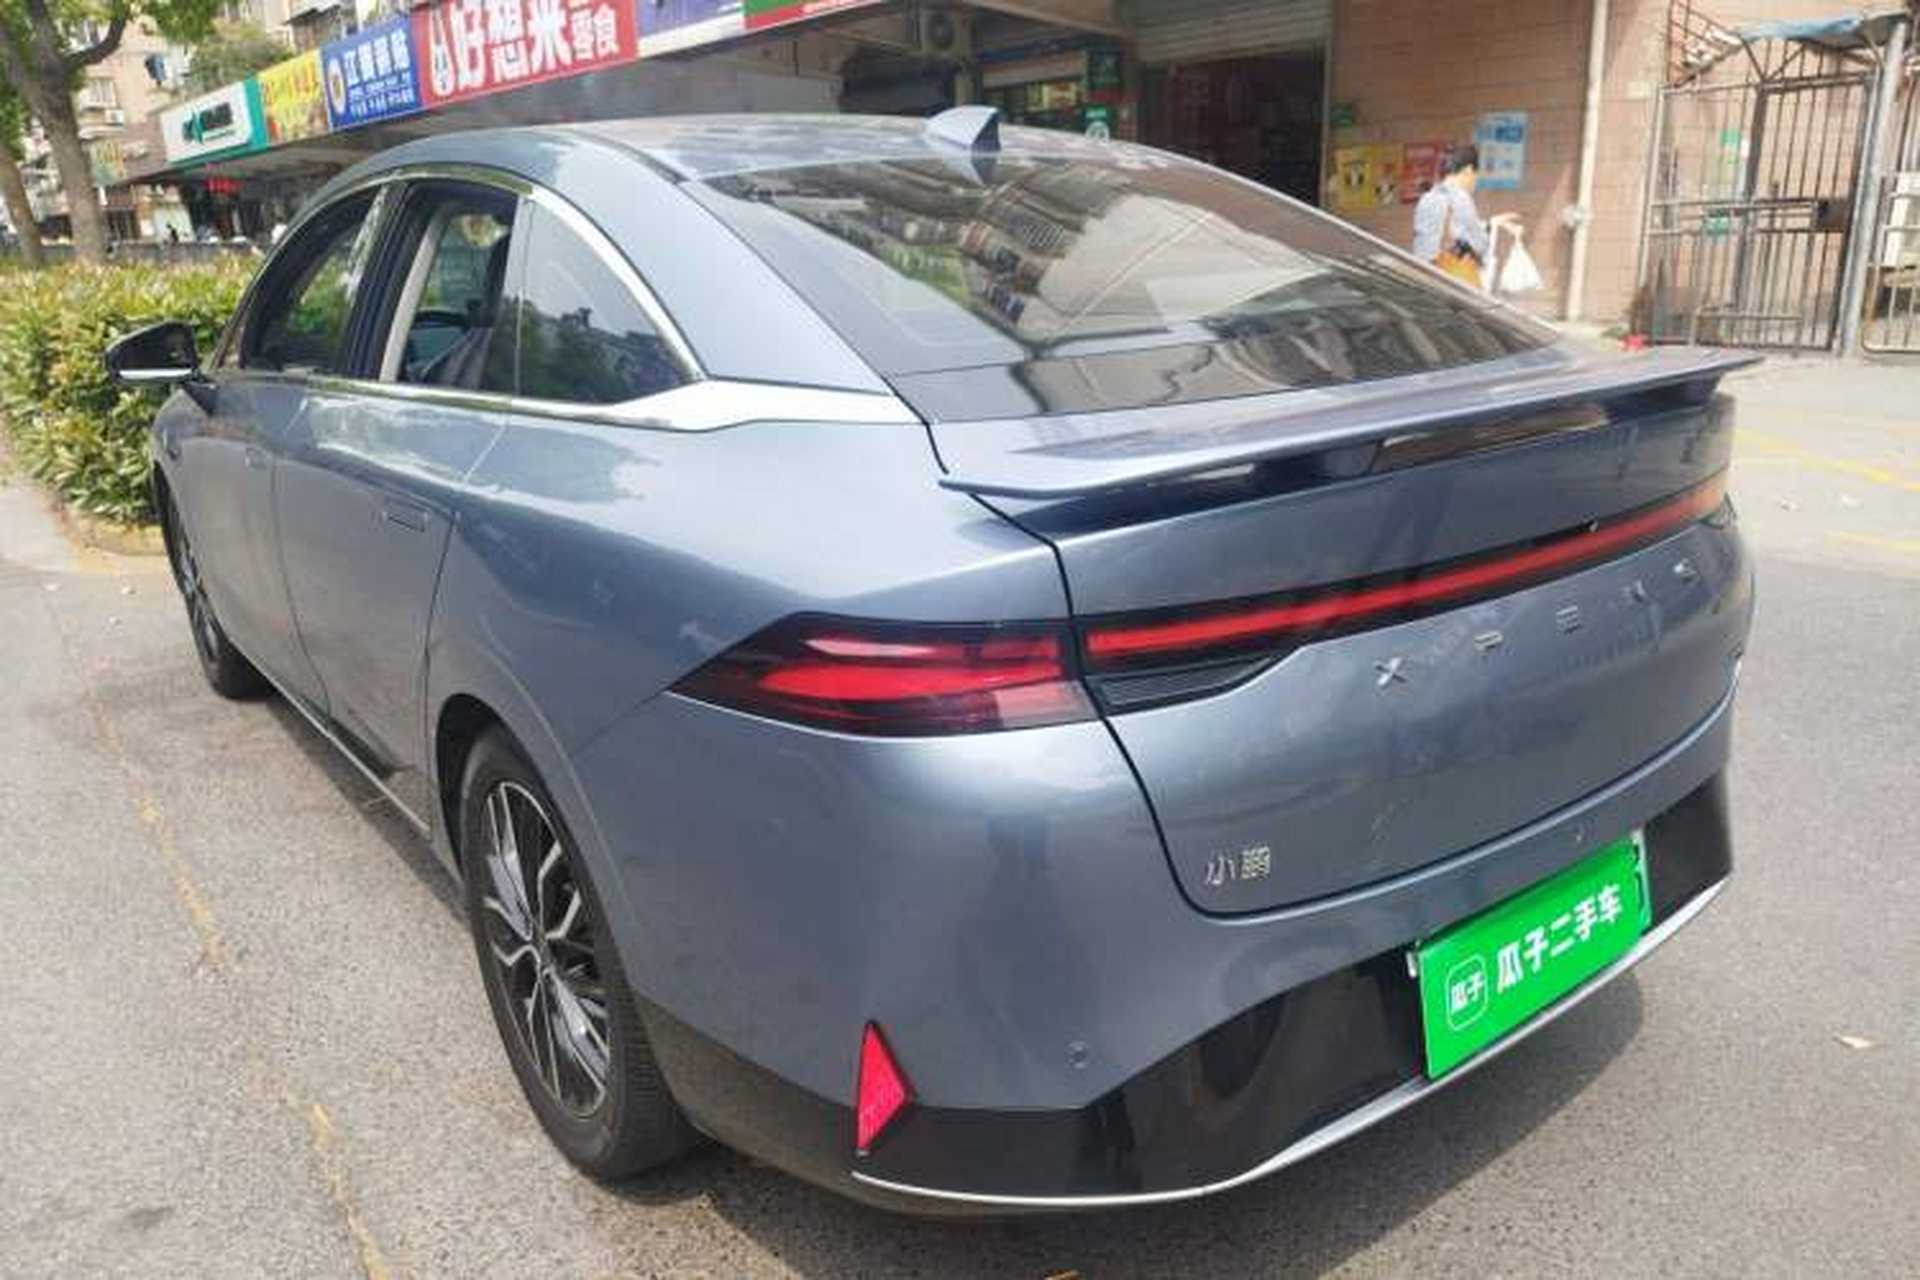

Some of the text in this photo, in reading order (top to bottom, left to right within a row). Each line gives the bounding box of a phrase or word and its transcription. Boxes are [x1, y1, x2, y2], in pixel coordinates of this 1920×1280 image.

[1205, 846, 1270, 885] 小鹏
[1497, 884, 1622, 993] 瓜子二手车
[1450, 970, 1484, 1015] 瓜子
